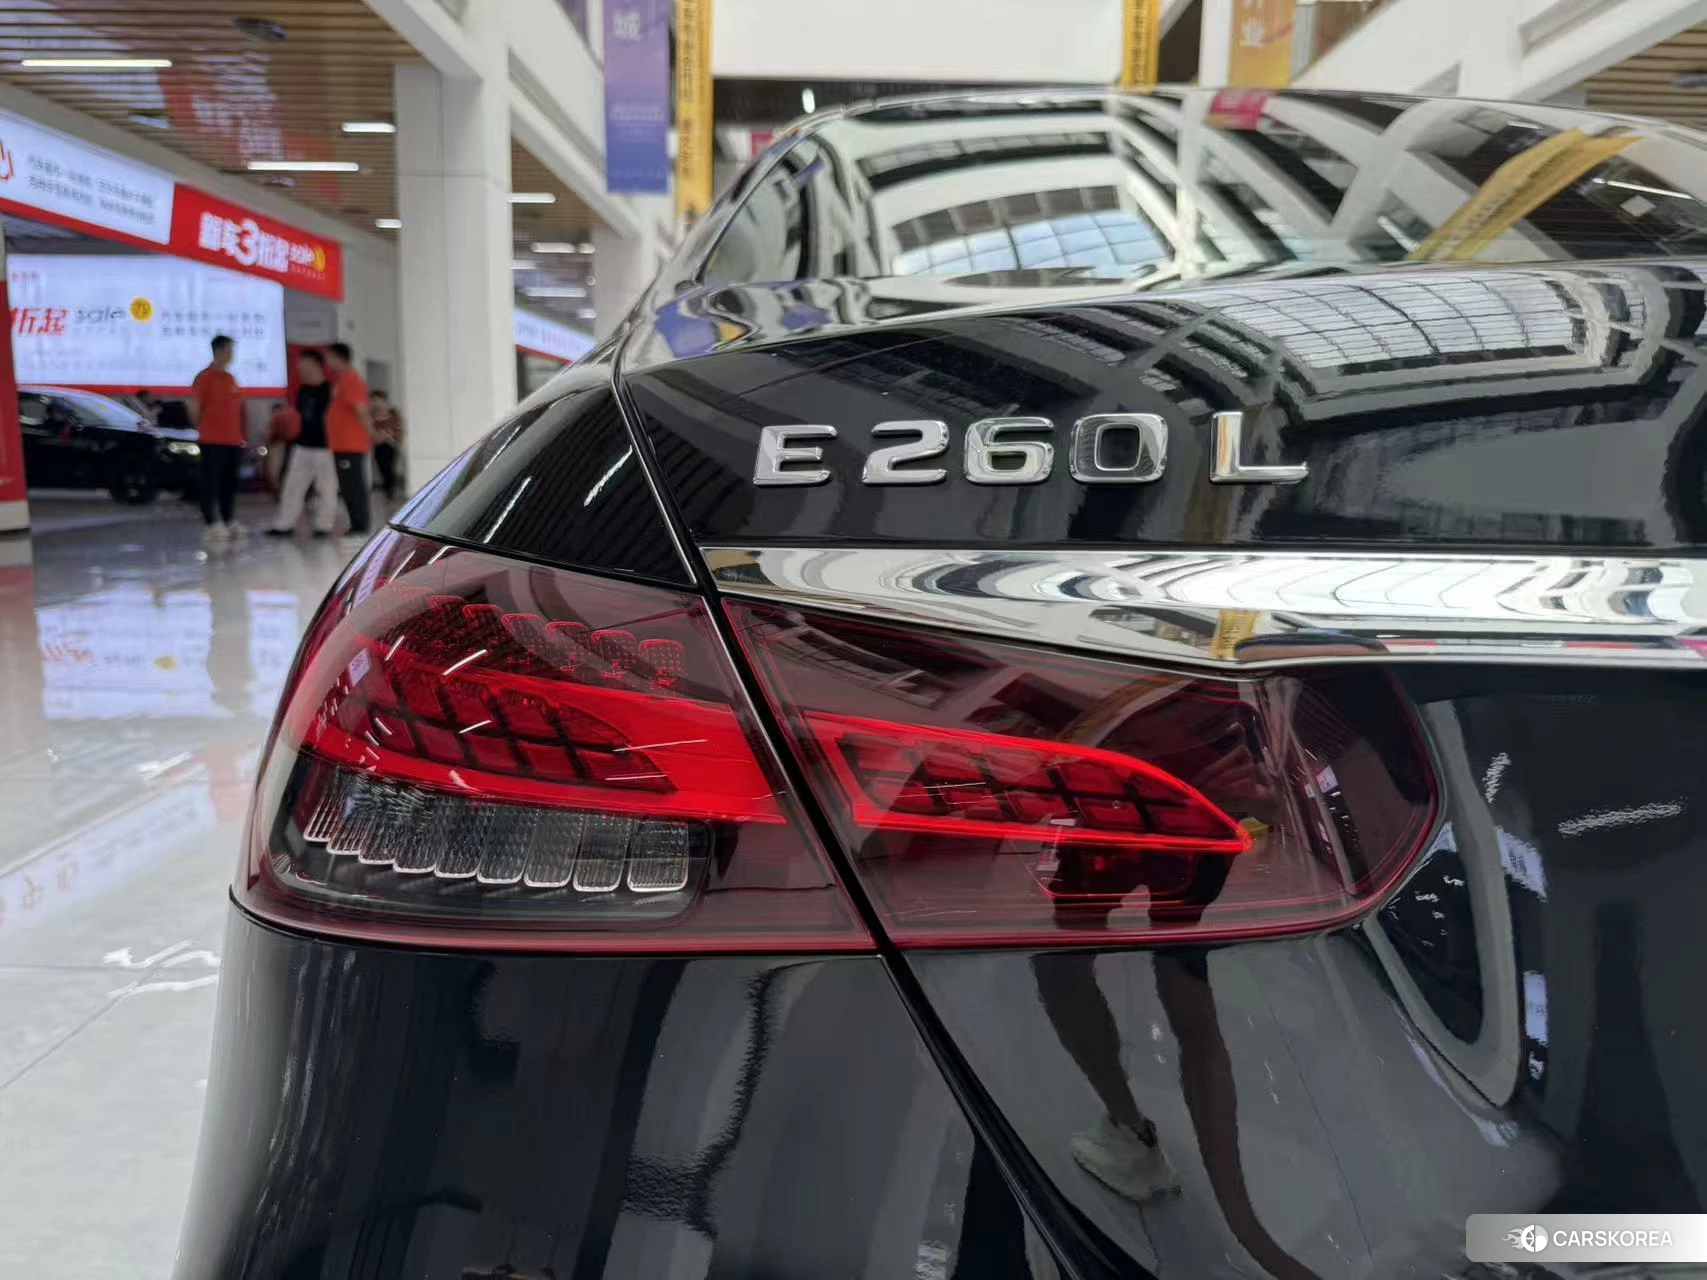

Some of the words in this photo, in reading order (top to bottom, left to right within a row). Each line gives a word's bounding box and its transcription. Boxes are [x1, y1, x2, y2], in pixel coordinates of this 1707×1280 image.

[753, 424, 838, 486] E
[862, 412, 1169, 486] 260
[1209, 411, 1310, 484] L
